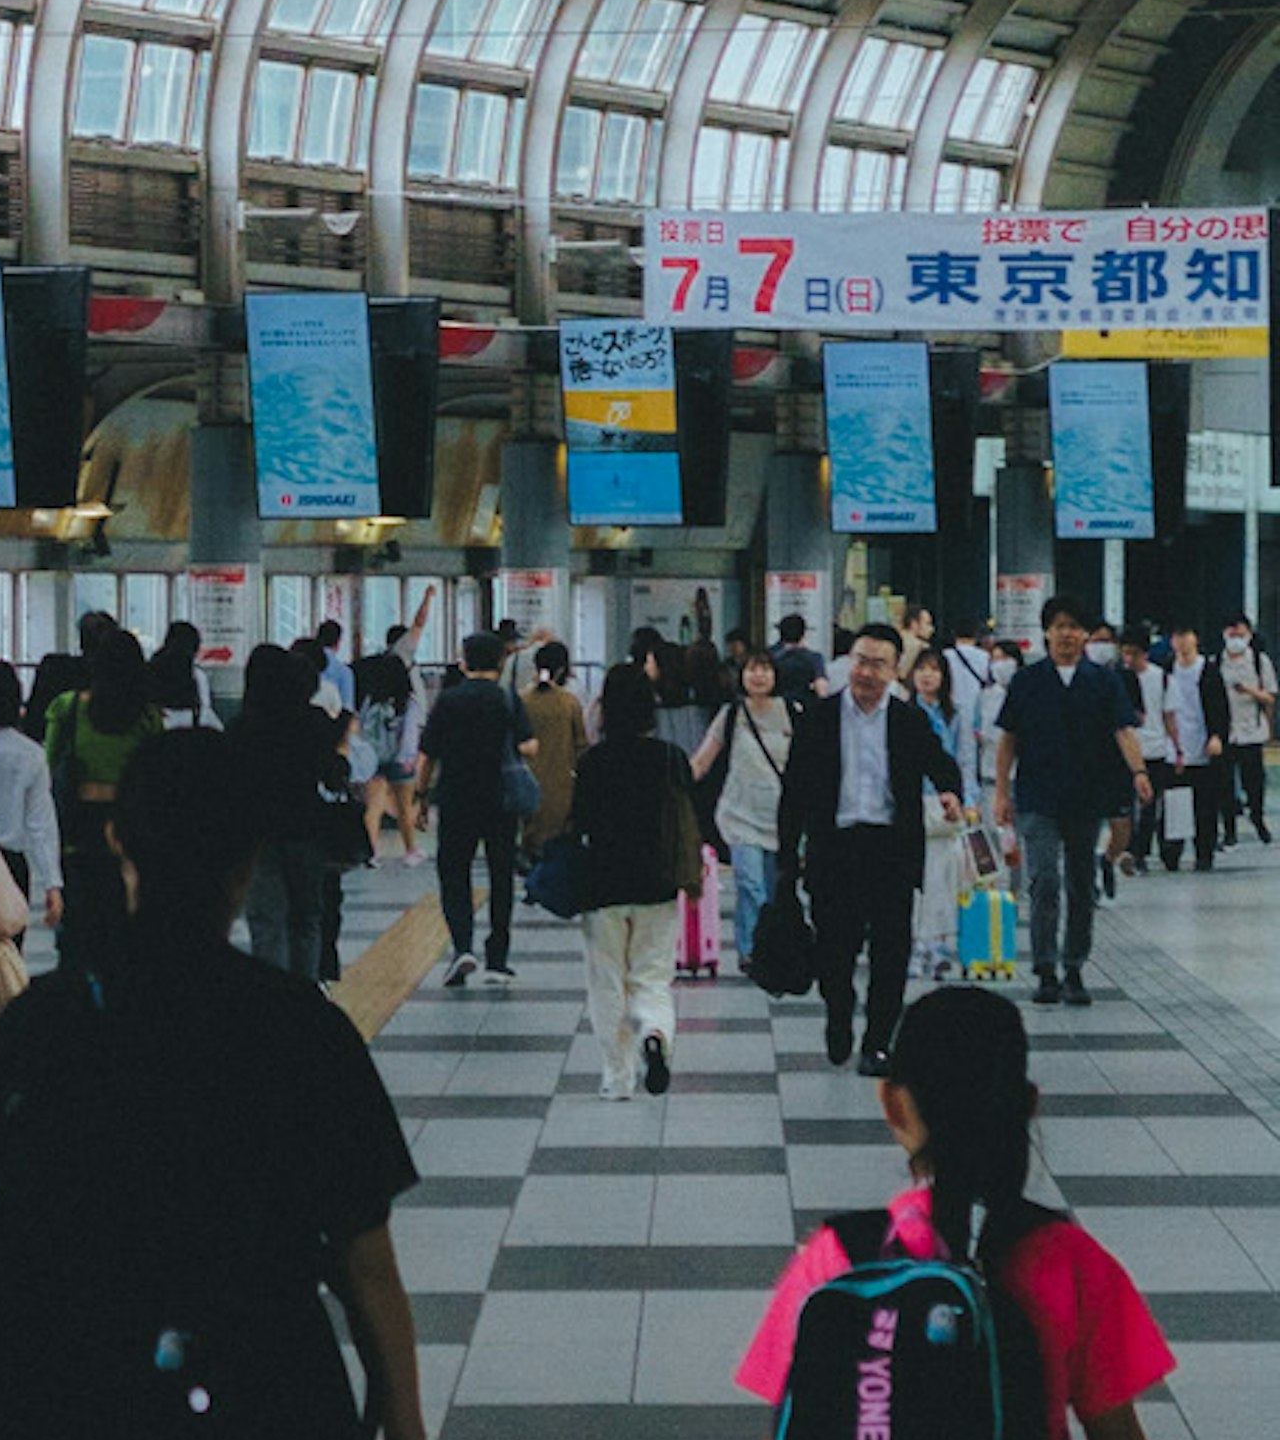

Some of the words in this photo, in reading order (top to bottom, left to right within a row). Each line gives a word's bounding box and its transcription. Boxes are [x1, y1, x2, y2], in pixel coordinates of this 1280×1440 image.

[659, 219, 726, 244] 投票日
[982, 218, 1087, 245] 投票で
[906, 248, 1261, 305] 東京都知
